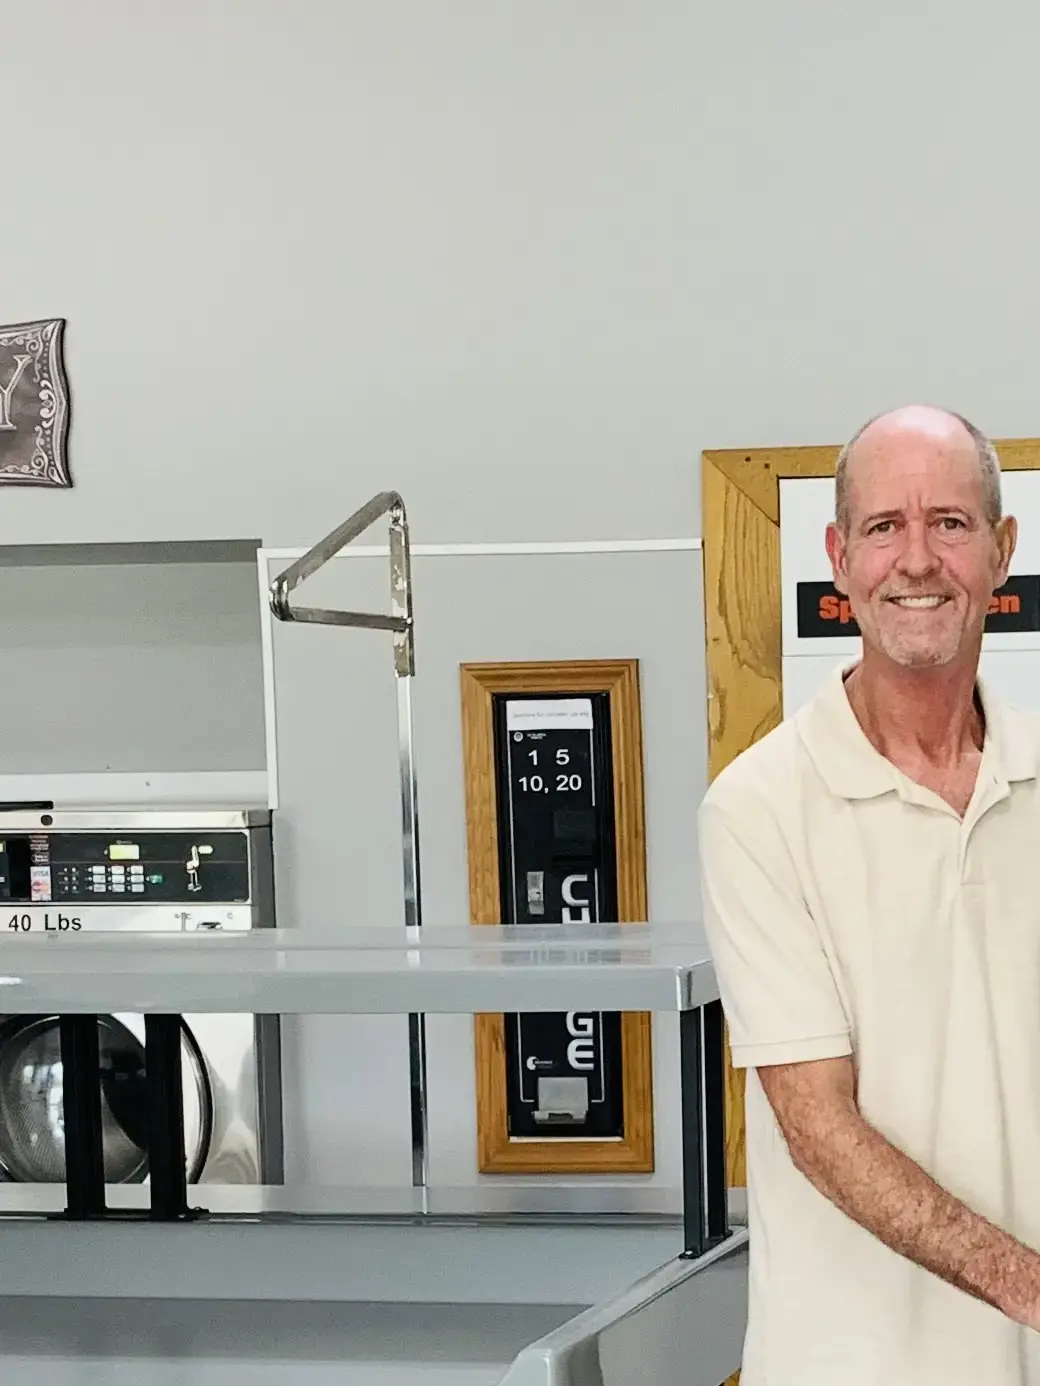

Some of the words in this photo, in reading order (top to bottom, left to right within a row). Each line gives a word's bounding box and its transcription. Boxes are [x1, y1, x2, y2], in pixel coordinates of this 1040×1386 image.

[528, 749, 538, 766] 1
[556, 748, 570, 766] 5
[518, 775, 549, 794] 10,
[556, 774, 582, 791] 20
[8, 914, 31, 932] 40
[44, 913, 82, 931] Lbs
[561, 874, 595, 1071] CHGE
